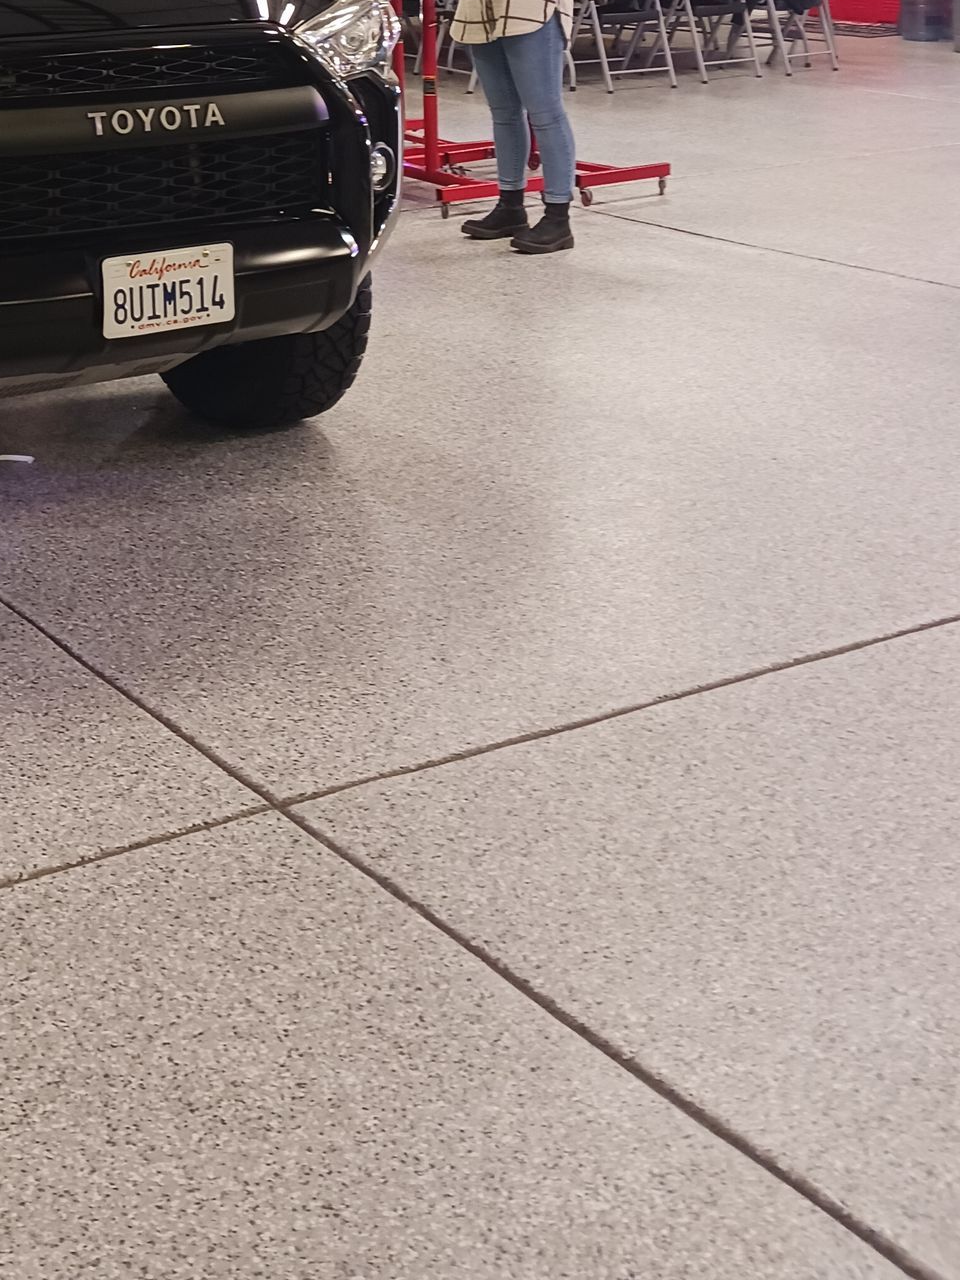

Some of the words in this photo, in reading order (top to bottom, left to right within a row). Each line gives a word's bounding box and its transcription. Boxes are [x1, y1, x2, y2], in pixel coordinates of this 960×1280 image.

[87, 102, 226, 136] TOYOTA
[129, 257, 209, 280] California
[113, 275, 226, 325] 8UIM514
[138, 315, 203, 330] dmv.ca.gov
